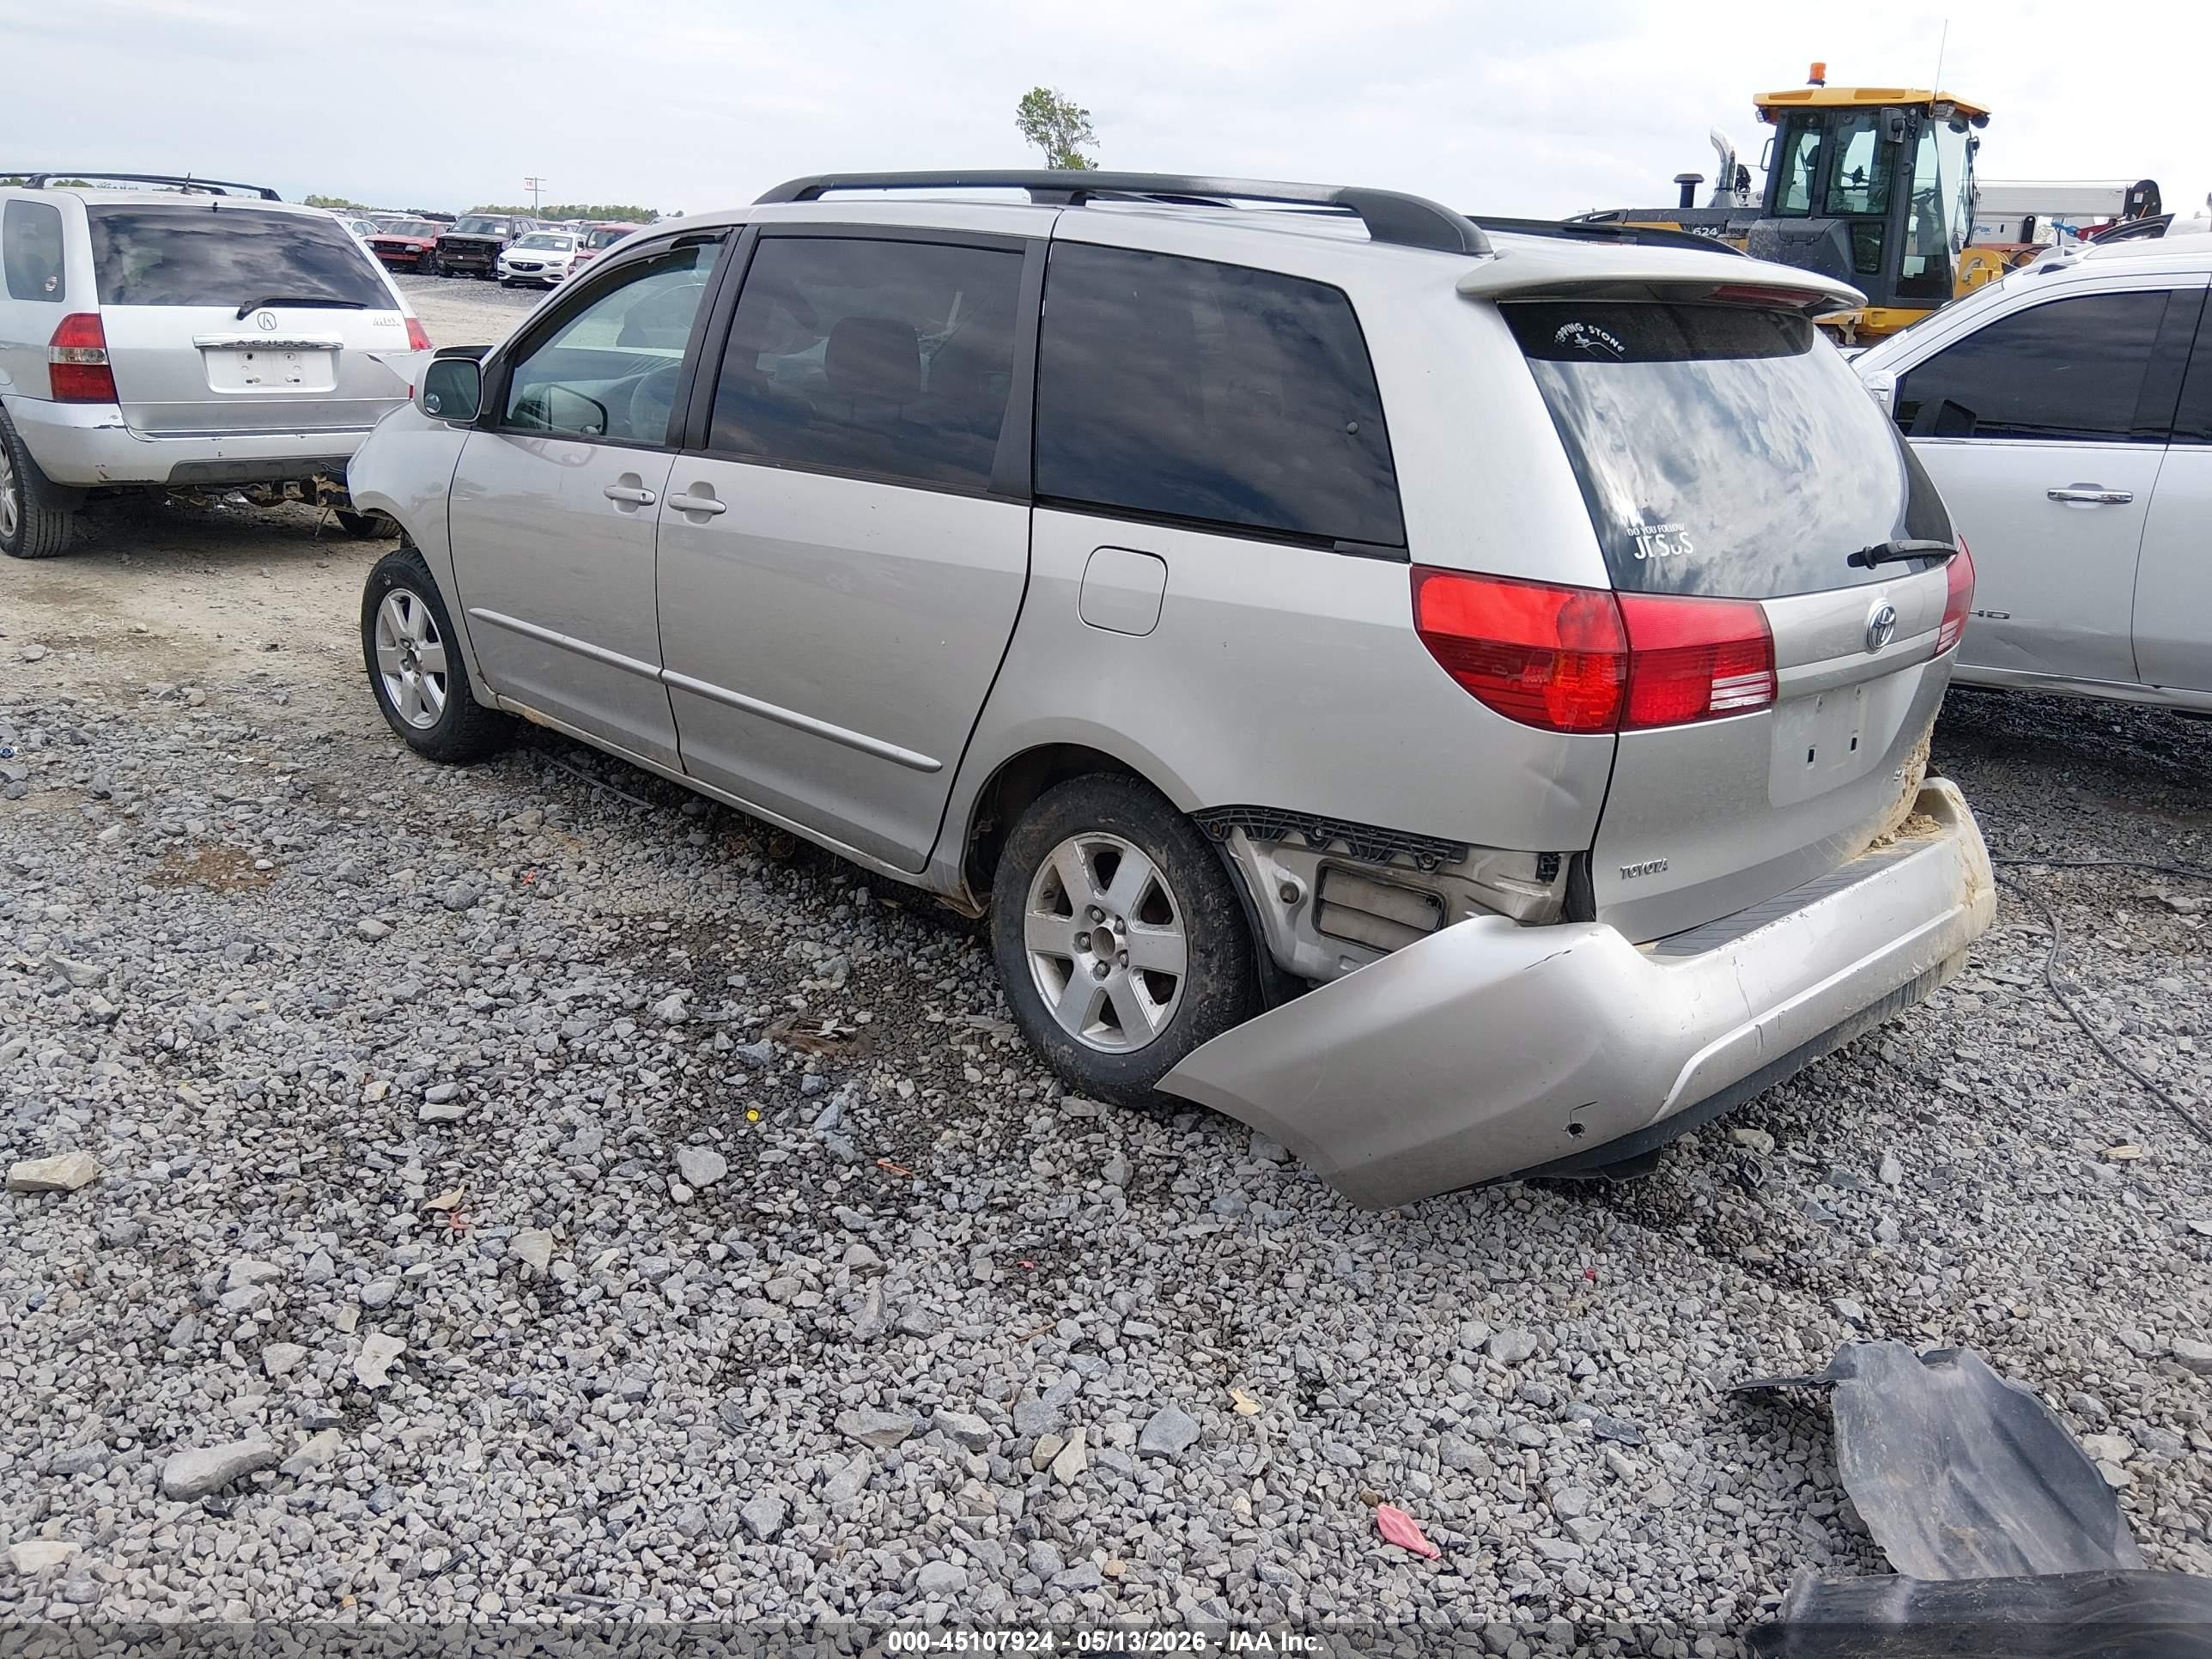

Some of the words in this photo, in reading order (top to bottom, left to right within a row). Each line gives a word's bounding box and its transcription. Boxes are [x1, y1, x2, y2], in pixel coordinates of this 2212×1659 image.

[1692, 227, 1717, 237] 624
[1626, 527, 1640, 537] DO
[1641, 525, 1657, 536] YOU
[1657, 522, 1685, 533] FOLLOW
[1620, 858, 1668, 880] TOYOTA
